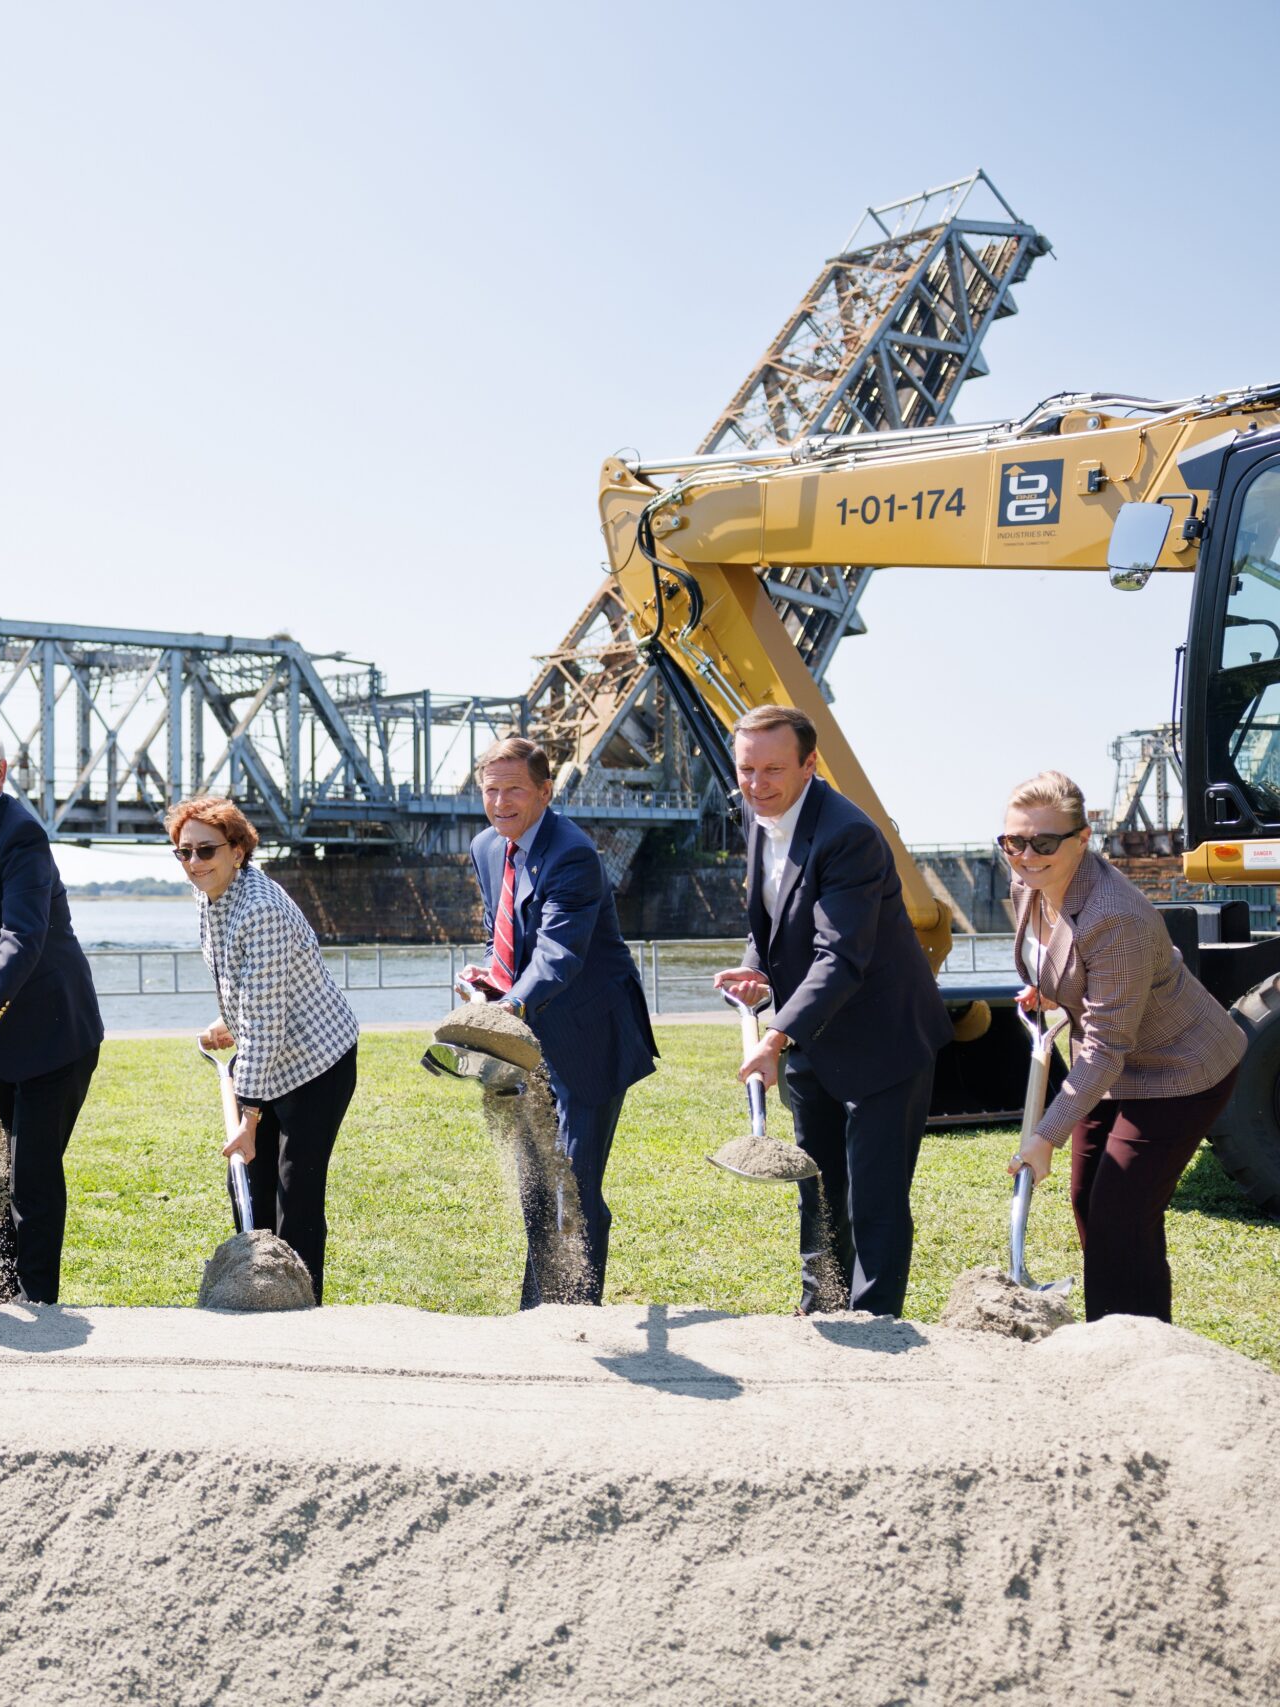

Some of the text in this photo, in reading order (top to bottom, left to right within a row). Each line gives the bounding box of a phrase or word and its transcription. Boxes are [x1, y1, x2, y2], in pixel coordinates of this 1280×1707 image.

[836, 487, 966, 526] 1-01-174
[1006, 498, 1047, 522] G
[997, 530, 1041, 539] INDUSTRIES
